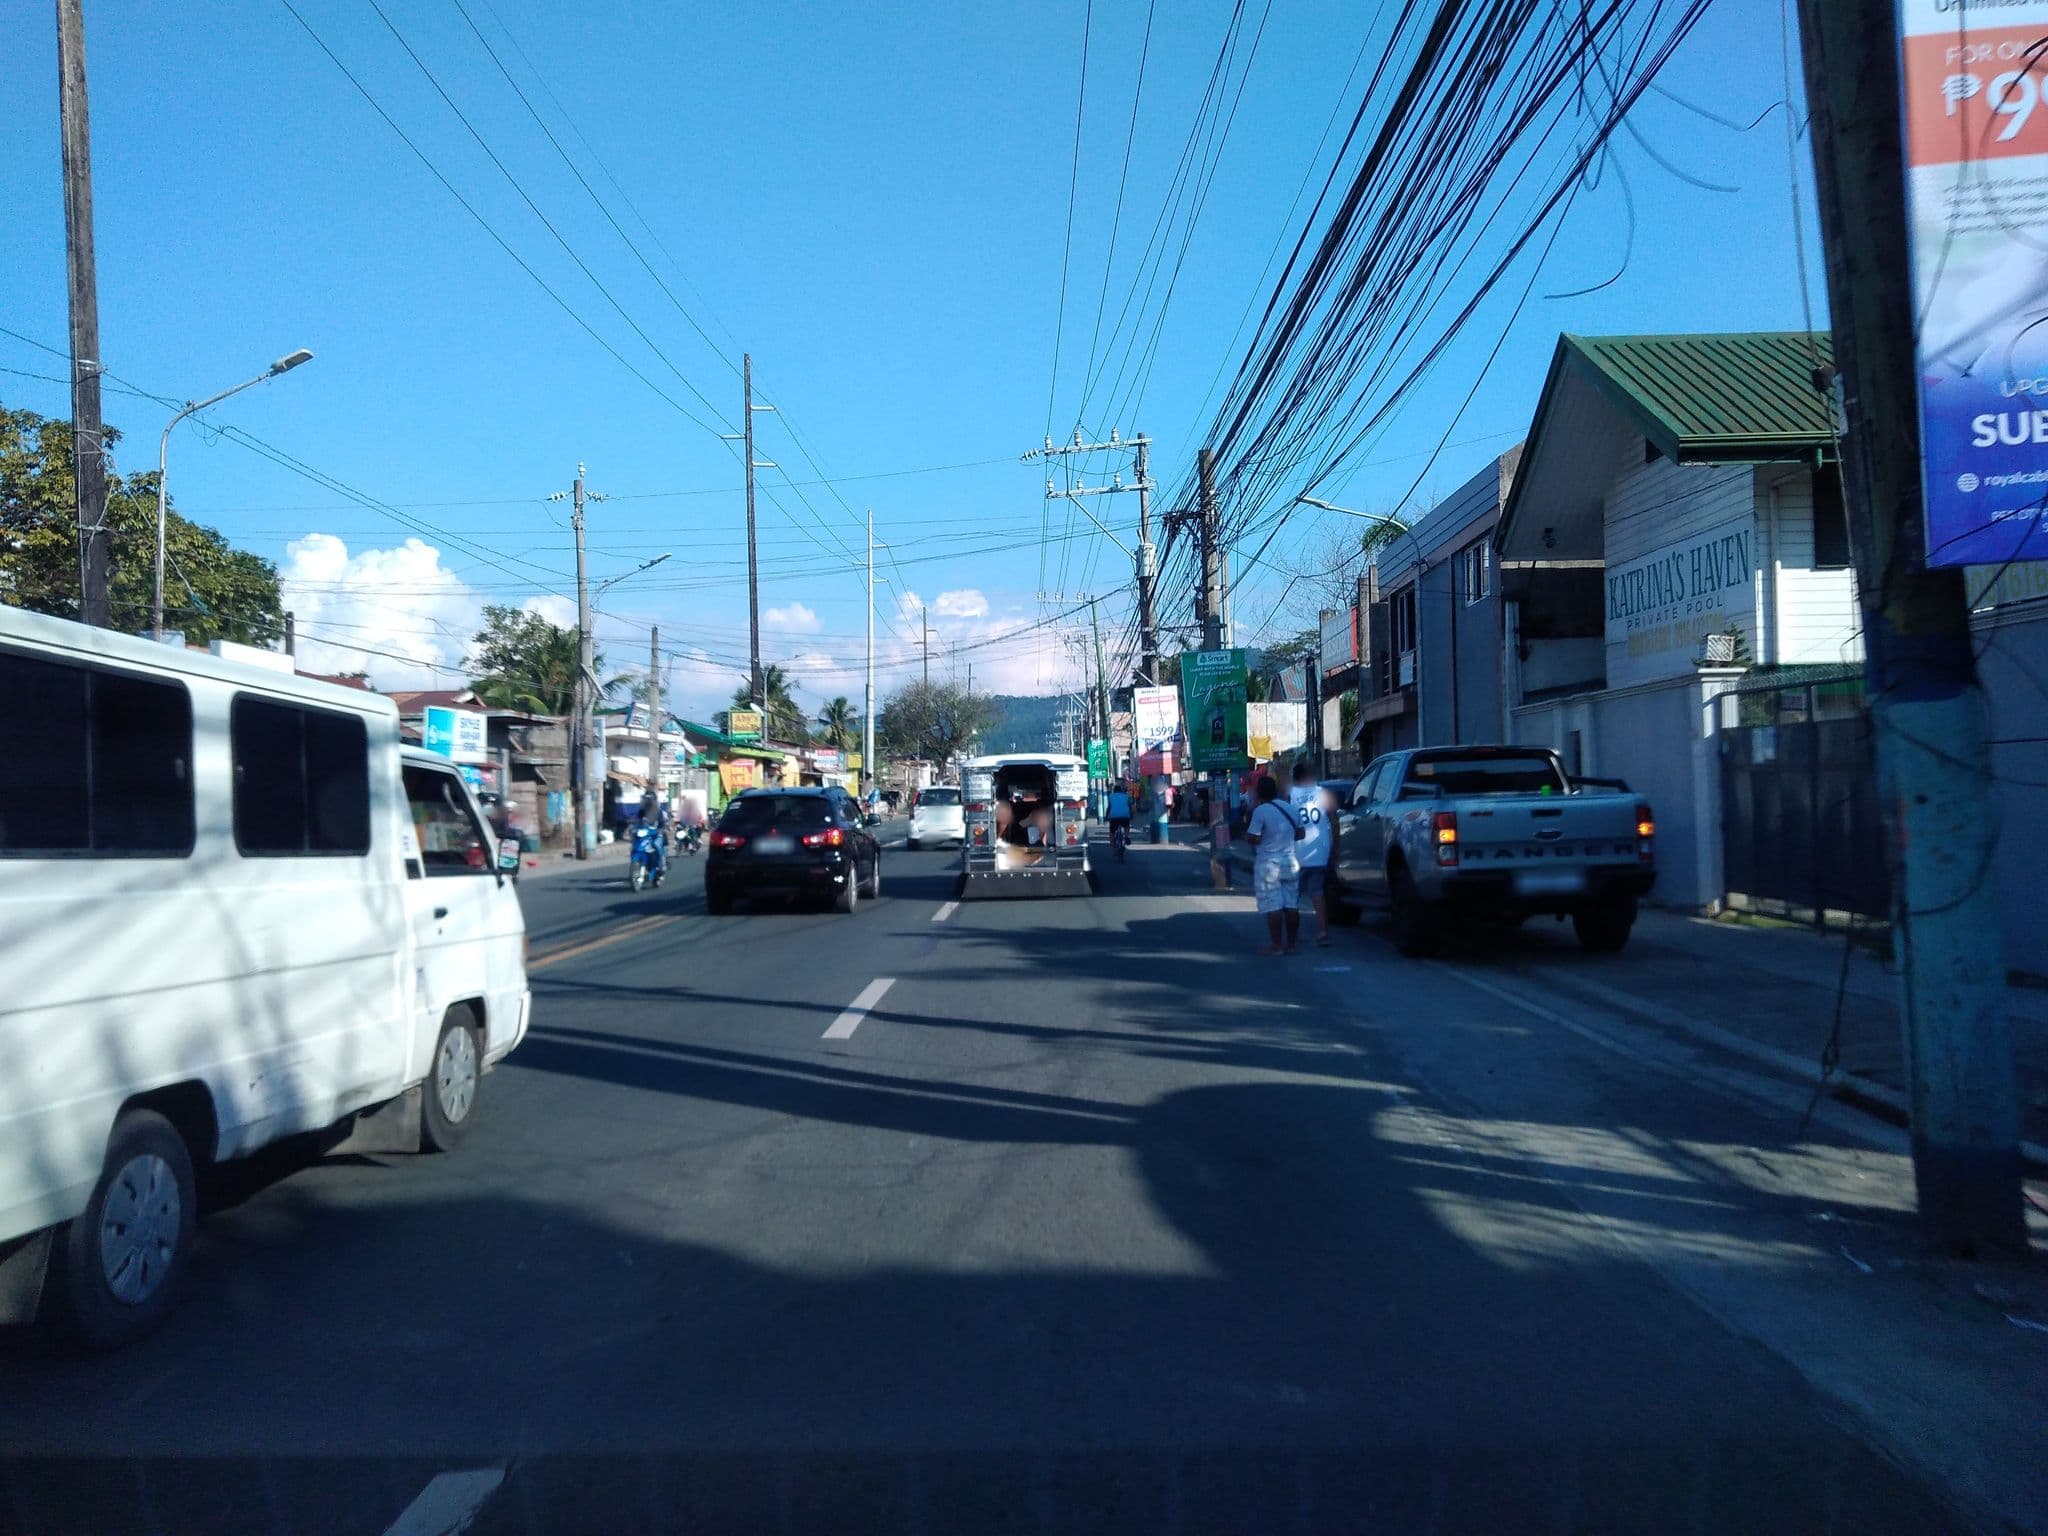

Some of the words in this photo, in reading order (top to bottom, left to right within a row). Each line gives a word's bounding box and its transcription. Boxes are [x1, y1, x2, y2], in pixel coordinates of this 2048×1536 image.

[1945, 44, 1994, 66] FOR
[1609, 551, 1685, 621] KATRINA'S
[1690, 529, 1750, 598] HAVEN
[1627, 608, 1679, 630] PRIVATE
[1686, 596, 1724, 614] POOL
[1149, 726, 1174, 737] 1599
[1298, 807, 1321, 824] 30
[1463, 844, 1634, 860] RANGER
